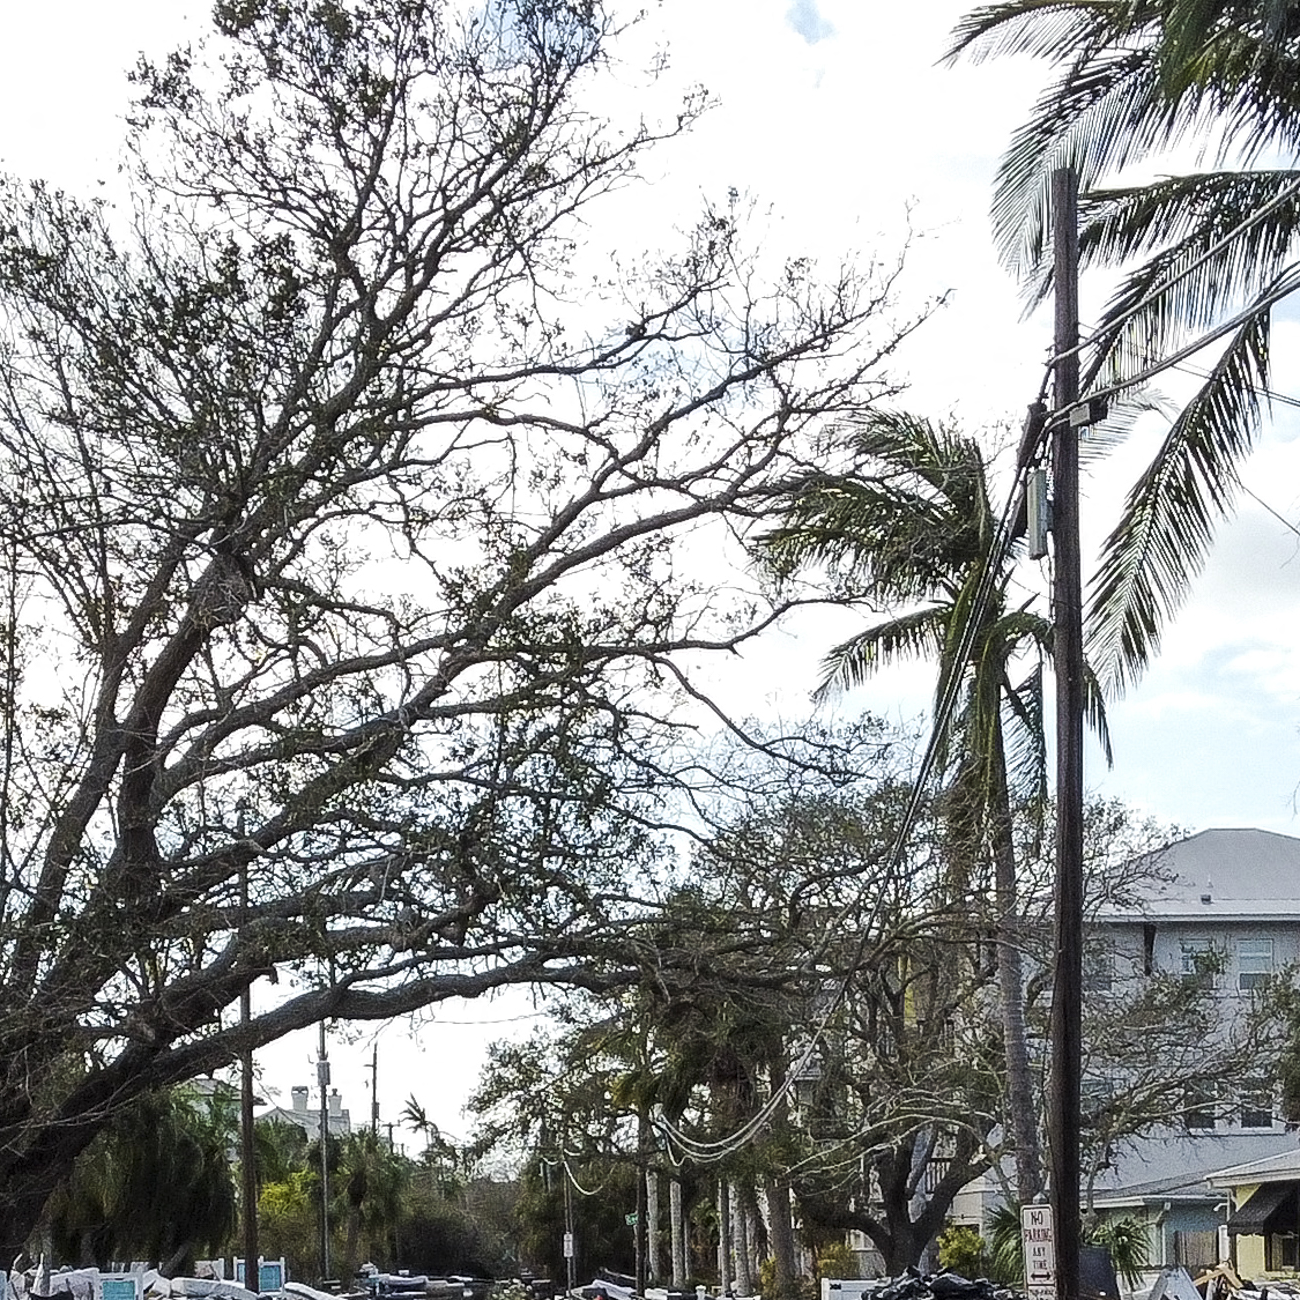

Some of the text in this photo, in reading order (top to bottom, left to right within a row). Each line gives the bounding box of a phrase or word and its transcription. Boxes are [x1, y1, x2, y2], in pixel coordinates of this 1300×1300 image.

[1030, 1210, 1044, 1226] NO
[1024, 1228, 1053, 1243] PARKING
[1032, 1247, 1046, 1257] ANY
[1032, 1260, 1048, 1270] TIME
